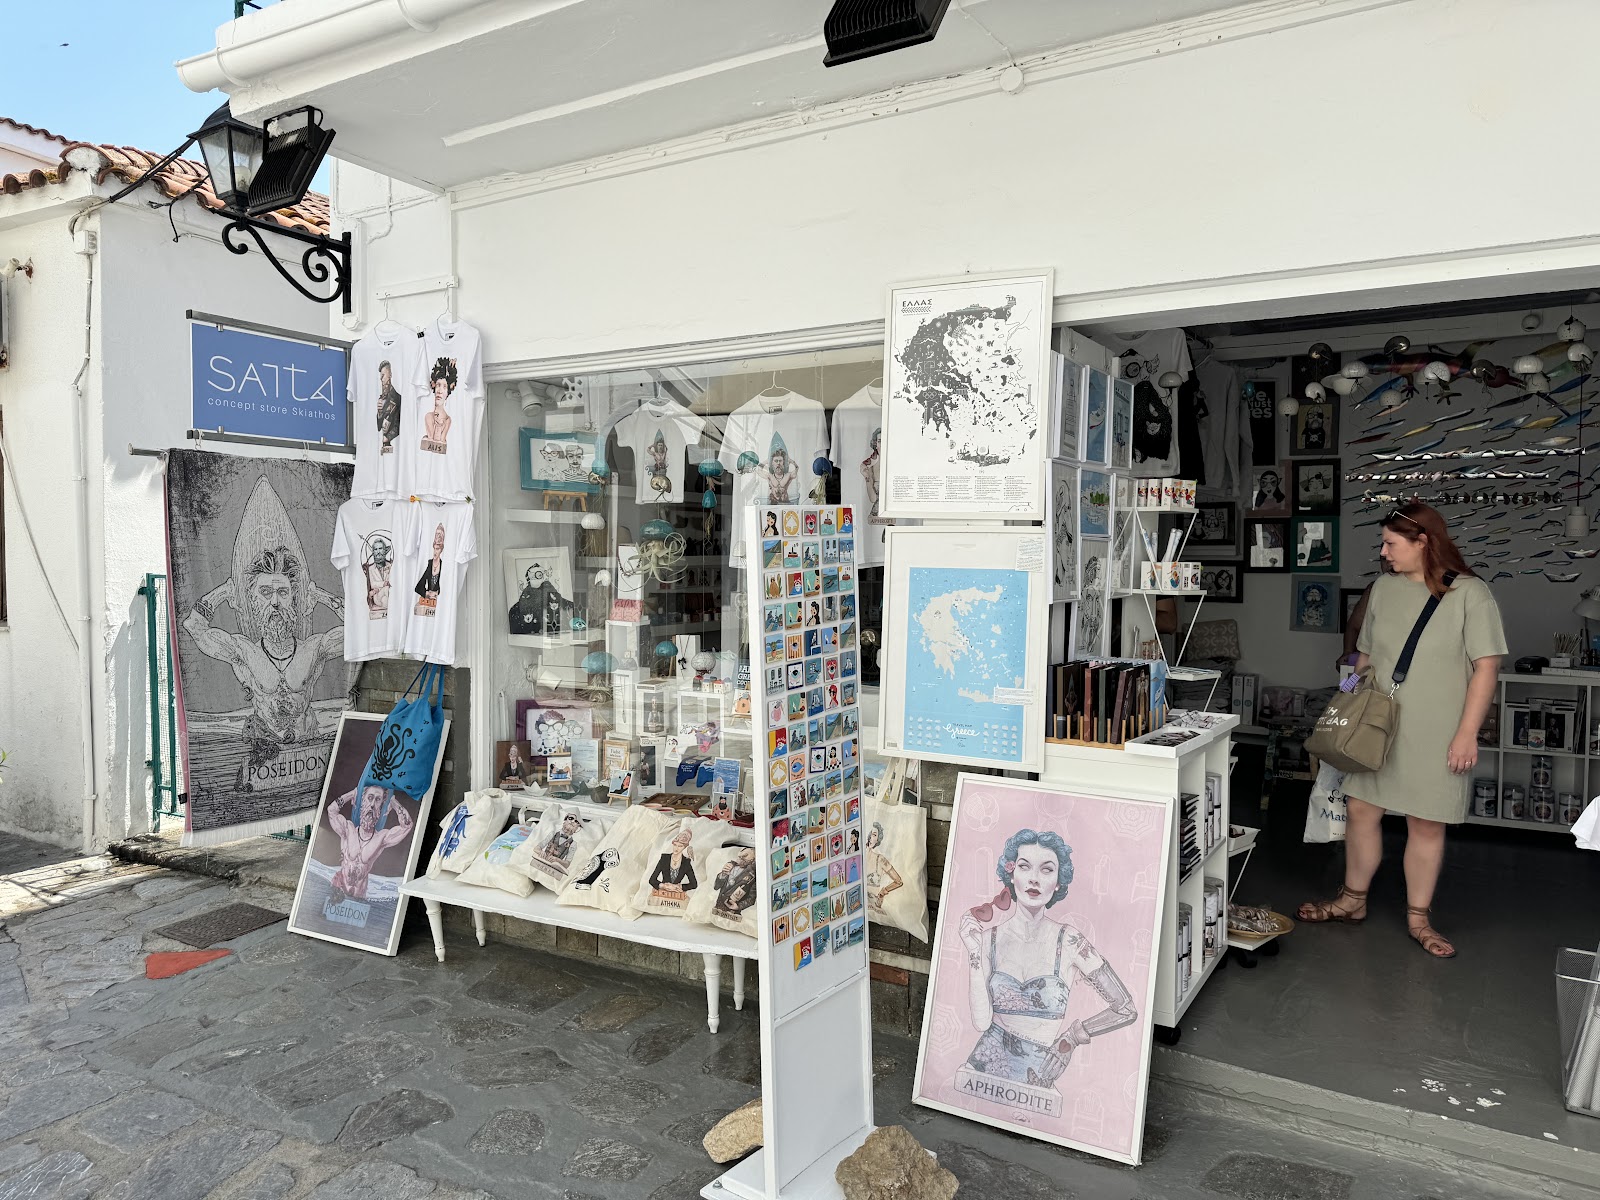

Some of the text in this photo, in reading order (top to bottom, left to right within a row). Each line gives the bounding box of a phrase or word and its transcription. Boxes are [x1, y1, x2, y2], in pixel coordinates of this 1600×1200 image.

[207, 355, 334, 406] SATTA
[207, 397, 336, 420] concept store Skiathos
[942, 723, 980, 739] Greece
[247, 753, 328, 781] POSEIDON
[1320, 807, 1348, 822] Mat
[325, 903, 368, 921] POSEIDON
[963, 1078, 1053, 1111] APHRODITE
